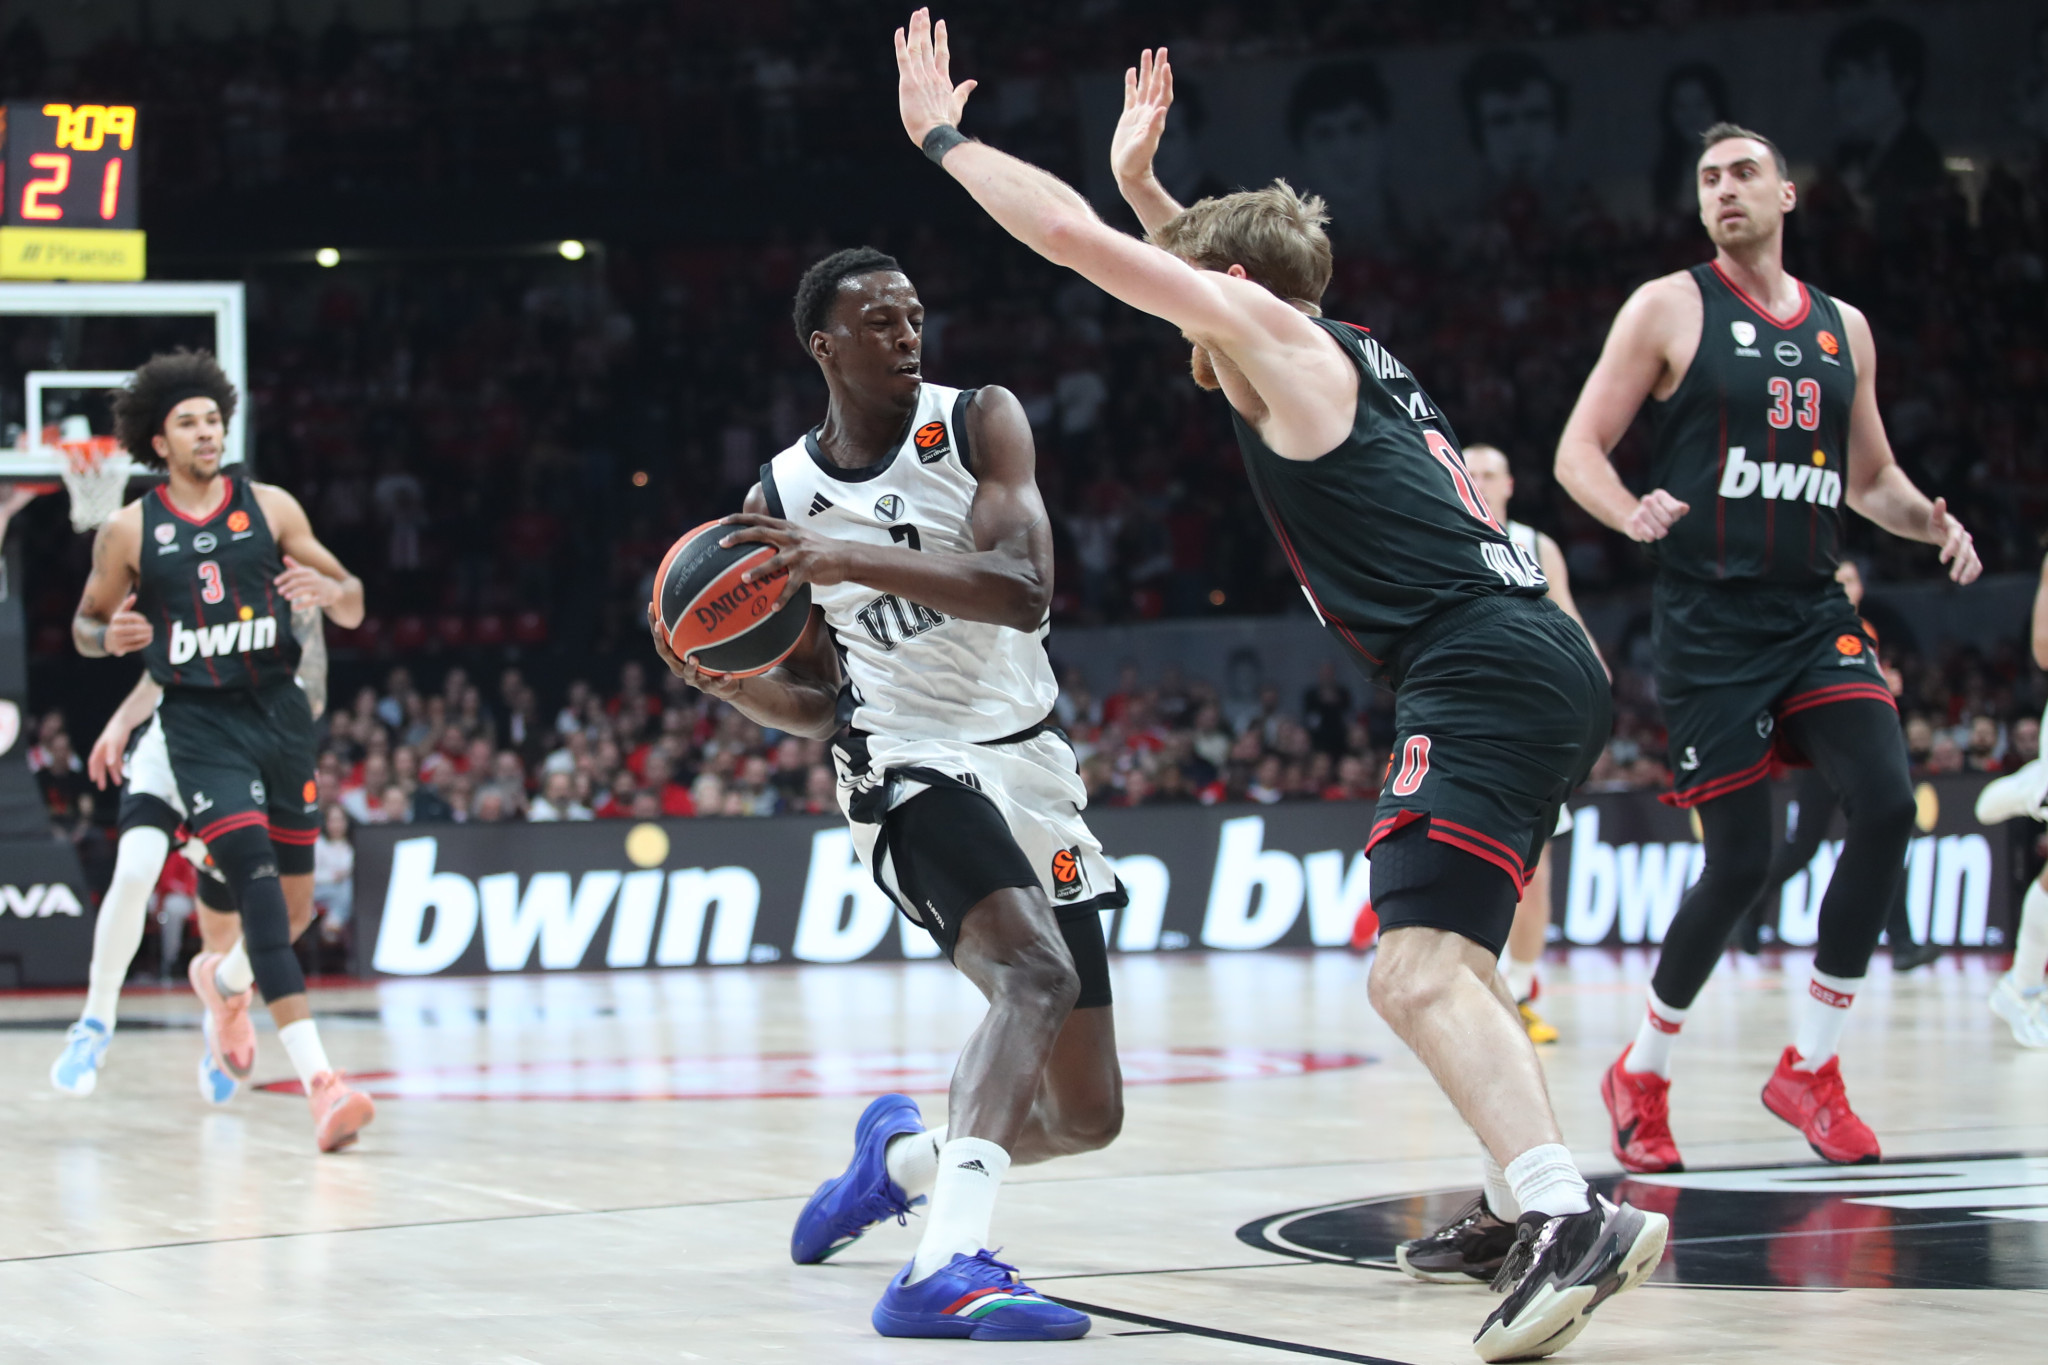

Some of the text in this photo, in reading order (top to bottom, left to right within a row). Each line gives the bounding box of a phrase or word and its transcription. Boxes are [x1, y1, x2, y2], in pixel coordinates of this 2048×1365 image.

[42, 104, 136, 151] 7:09
[1358, 338, 1409, 380] WAL
[1767, 376, 1821, 431] 33
[1423, 429, 1506, 537] 0
[1718, 447, 1842, 509] bwin
[198, 560, 225, 604] 3
[169, 605, 277, 665] bwin
[1392, 734, 1431, 796] 0
[0, 883, 83, 919] VA
[373, 823, 761, 976] bwin
